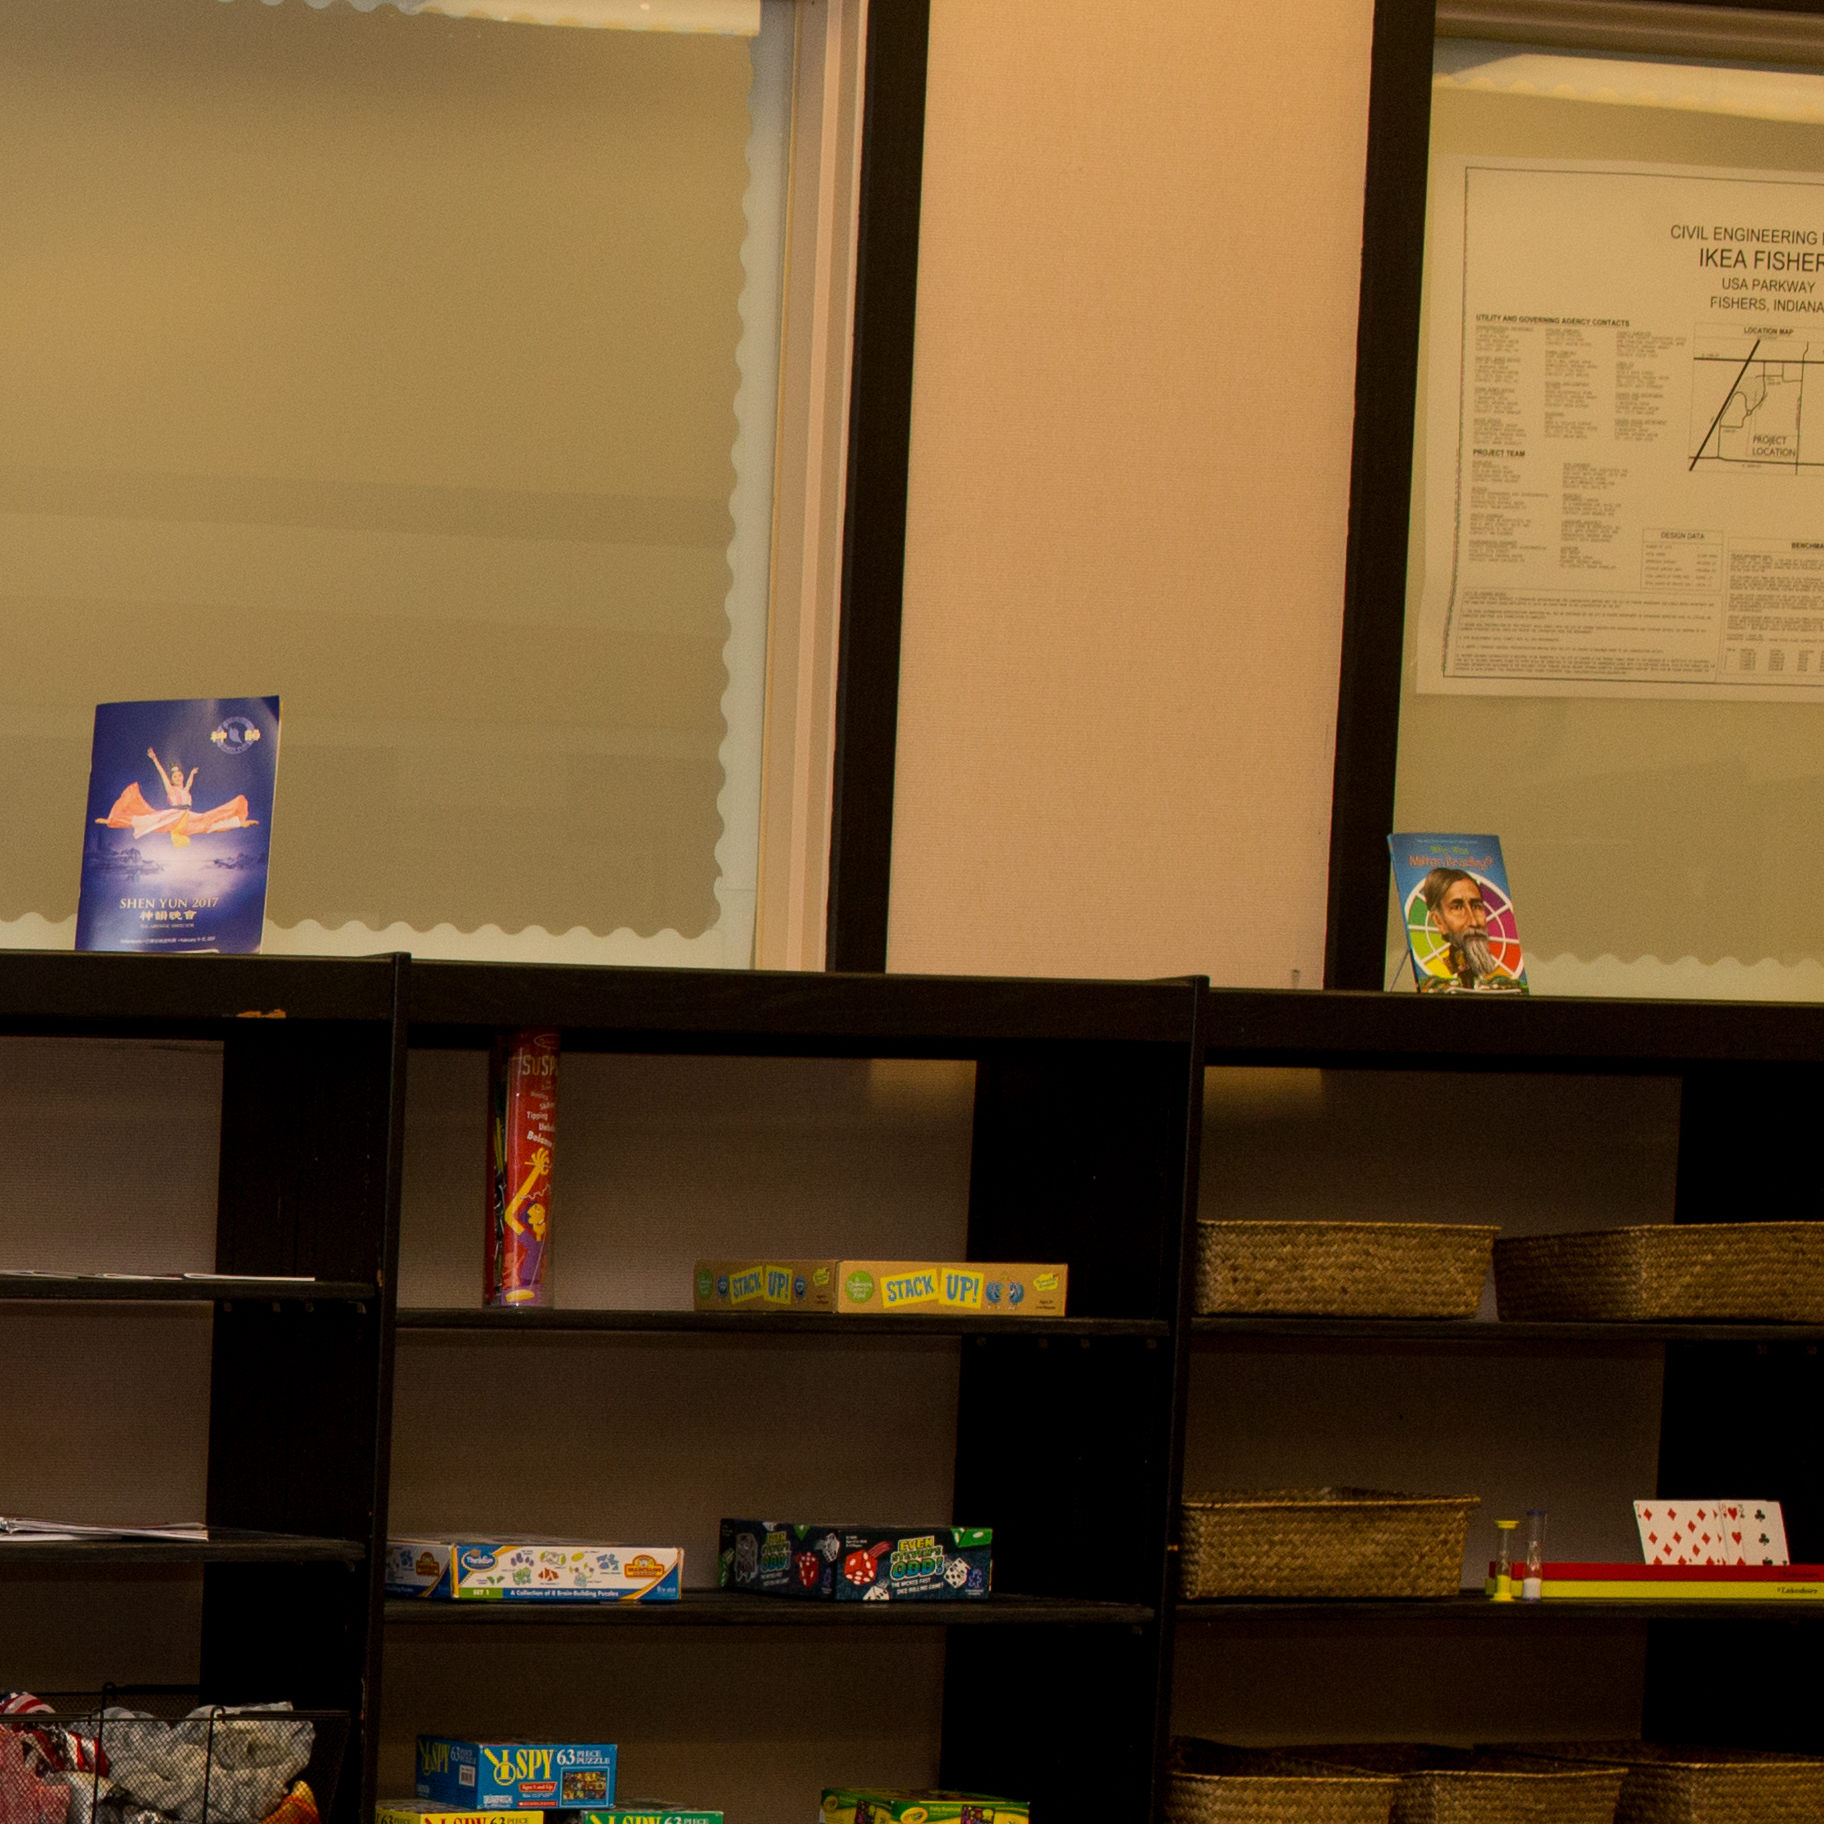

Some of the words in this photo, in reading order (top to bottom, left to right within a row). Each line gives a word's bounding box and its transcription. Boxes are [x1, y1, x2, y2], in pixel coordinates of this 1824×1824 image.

[1670, 224, 1708, 240] CIVIL
[1713, 226, 1818, 245] ENGINEERING
[1699, 248, 1747, 269] IKEA
[1722, 277, 1748, 290] USA
[1752, 278, 1816, 293] PARKWAY
[1710, 296, 1770, 312] FISHERS,
[1476, 314, 1501, 322] UTILITY
[1519, 315, 1560, 324] GOVERNING
[1561, 317, 1590, 325] AGENCY
[1592, 318, 1630, 327] CONTACTS
[1753, 435, 1786, 446] PROJECT
[1473, 449, 1504, 457] PROJECT
[1752, 448, 1796, 457] LOCATION
[120, 898, 155, 909] SHEN
[159, 898, 188, 908] YUN
[192, 898, 219, 908] 2017
[732, 1272, 762, 1299] STACK
[768, 1271, 790, 1298] UP!
[886, 1275, 934, 1302] STACK
[946, 1273, 979, 1303] UP!
[899, 1538, 933, 1551] EVEN
[893, 1557, 943, 1579] ODD!
[557, 1590, 596, 1598] Brain-Building
[432, 1743, 450, 1773] SPY
[516, 1749, 554, 1779] SPY
[557, 1749, 576, 1765] 63
[576, 1757, 610, 1765] PUZZLE
